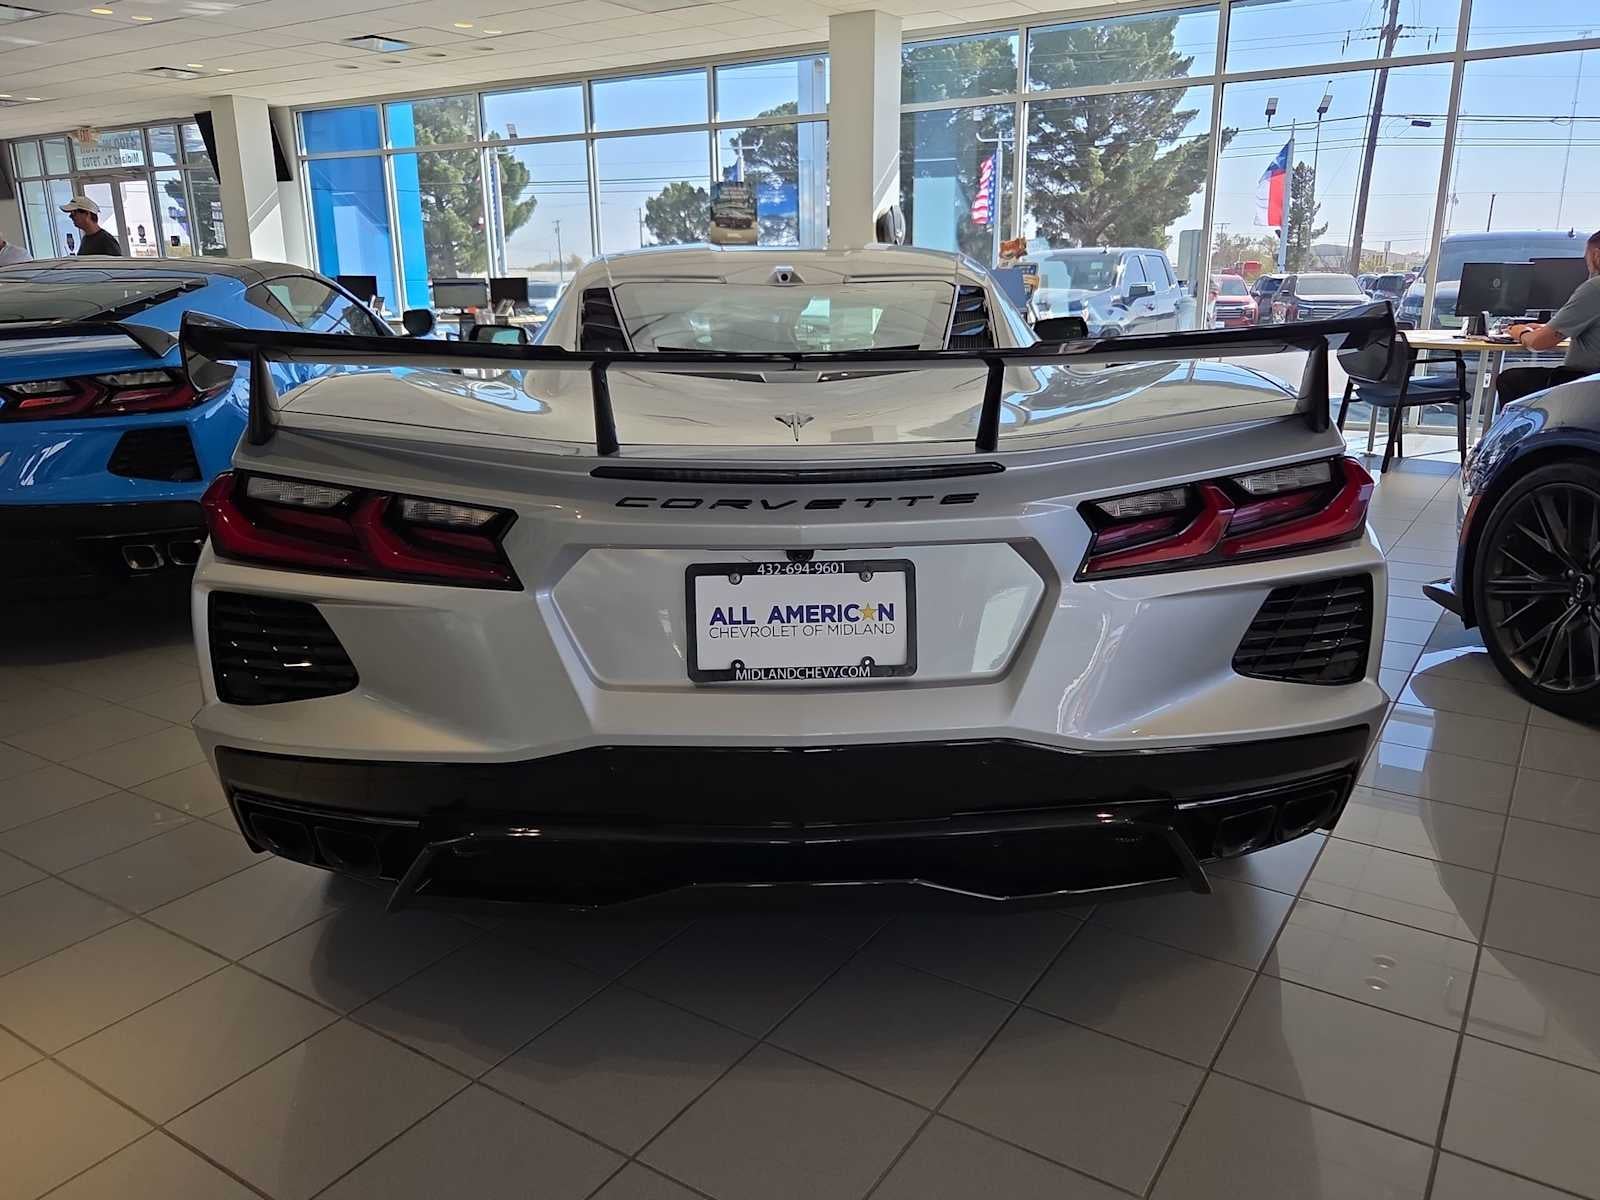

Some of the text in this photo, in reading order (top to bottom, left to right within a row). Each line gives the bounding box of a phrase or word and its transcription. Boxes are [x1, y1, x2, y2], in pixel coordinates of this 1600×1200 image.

[615, 492, 980, 510] CORVETTE
[757, 562, 846, 575] 432-694-9601
[710, 606, 756, 626] ALL
[709, 622, 896, 639] CHEVROLET OF MIDLAND
[735, 666, 871, 681] MIDLANDCHEVY.COM
